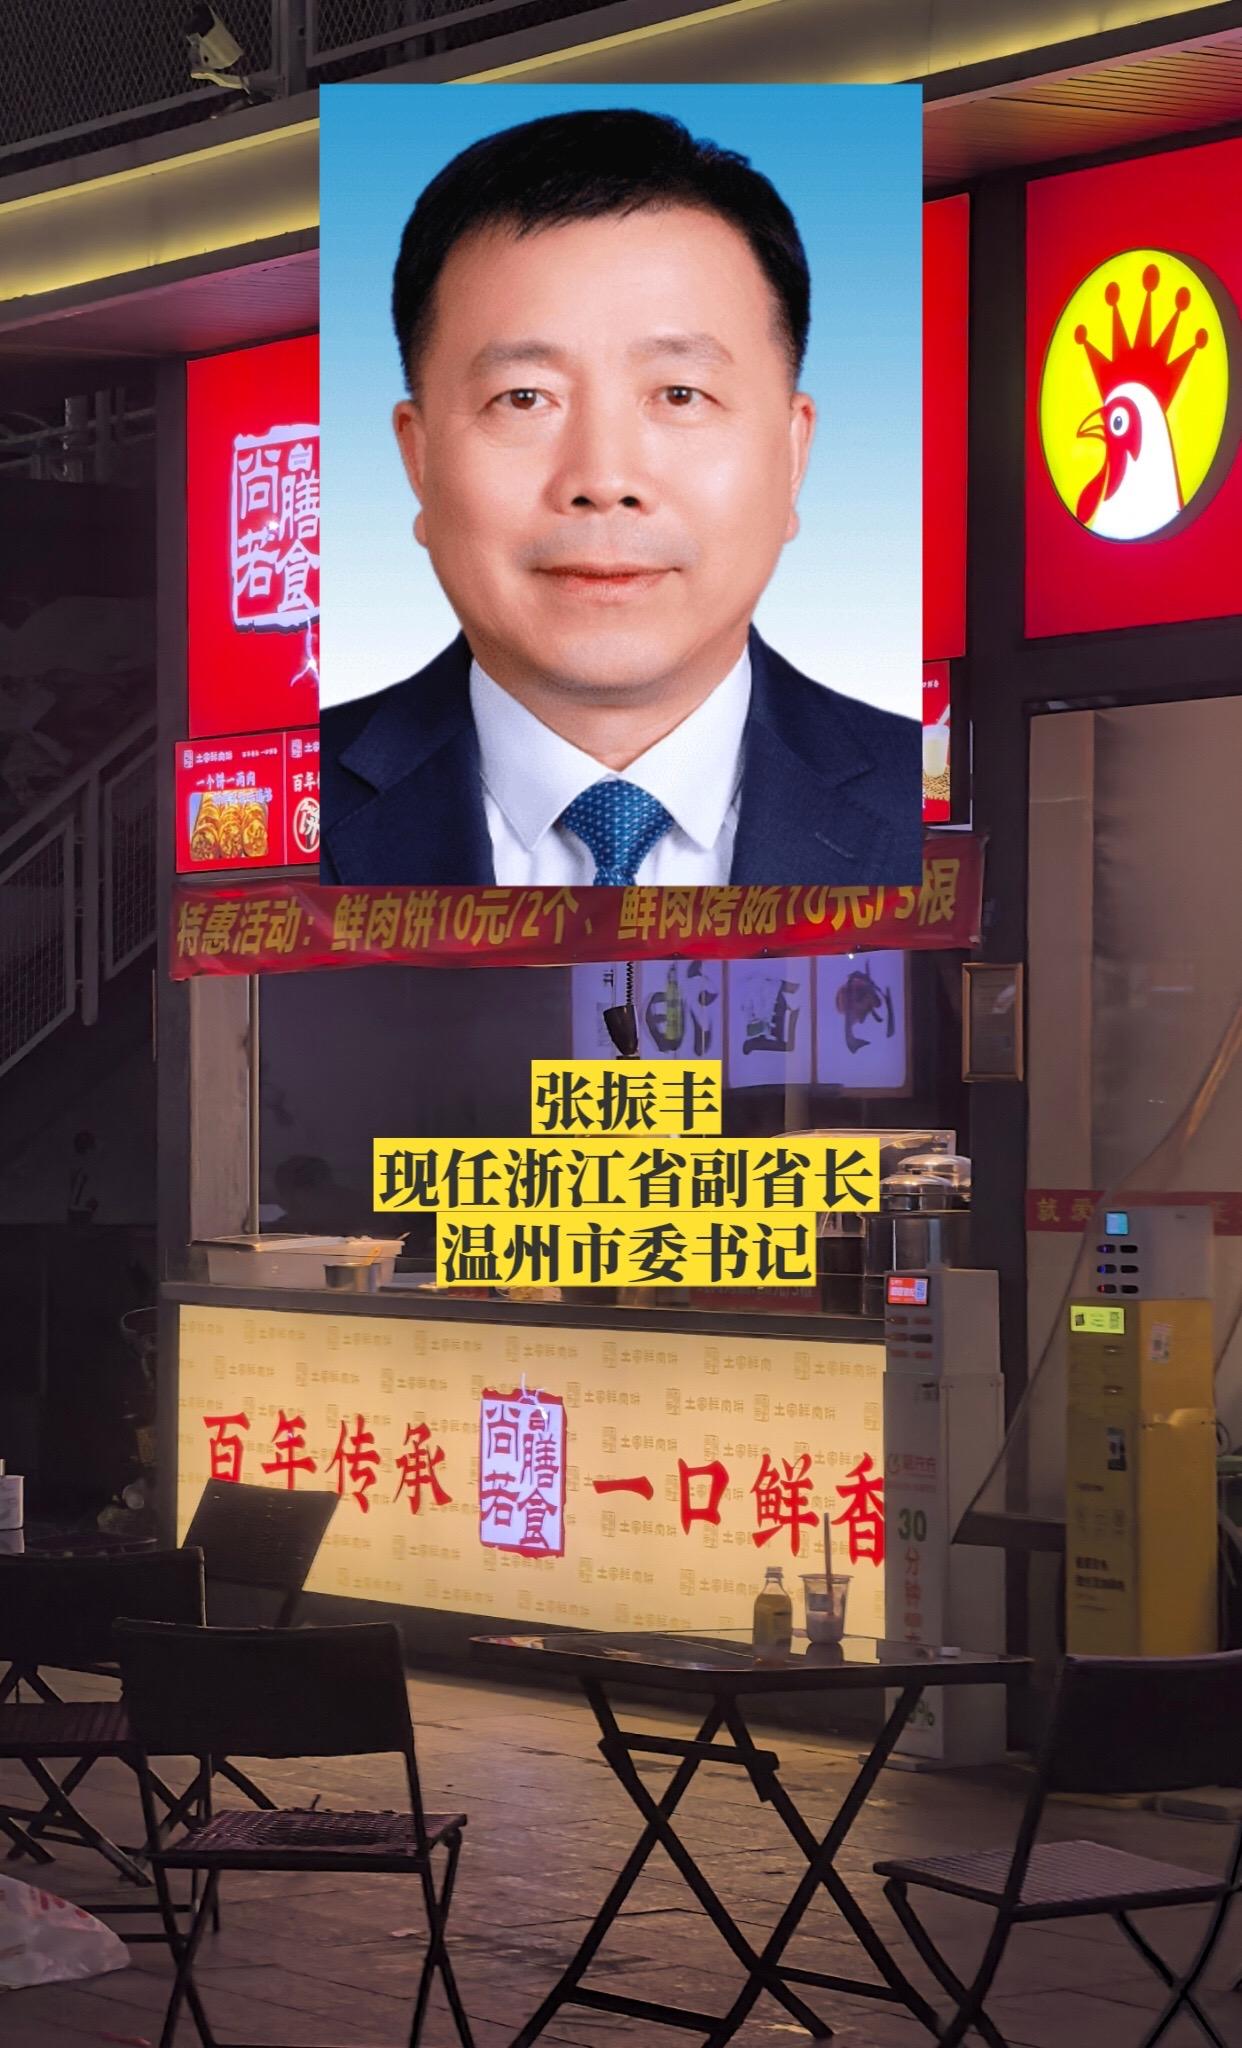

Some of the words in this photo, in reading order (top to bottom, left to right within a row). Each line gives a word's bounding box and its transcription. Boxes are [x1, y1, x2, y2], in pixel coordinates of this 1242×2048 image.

[203, 1409, 453, 1515] 百年传承
[592, 1451, 885, 1568] 一口鲜香
[898, 1508, 928, 1543] 30
